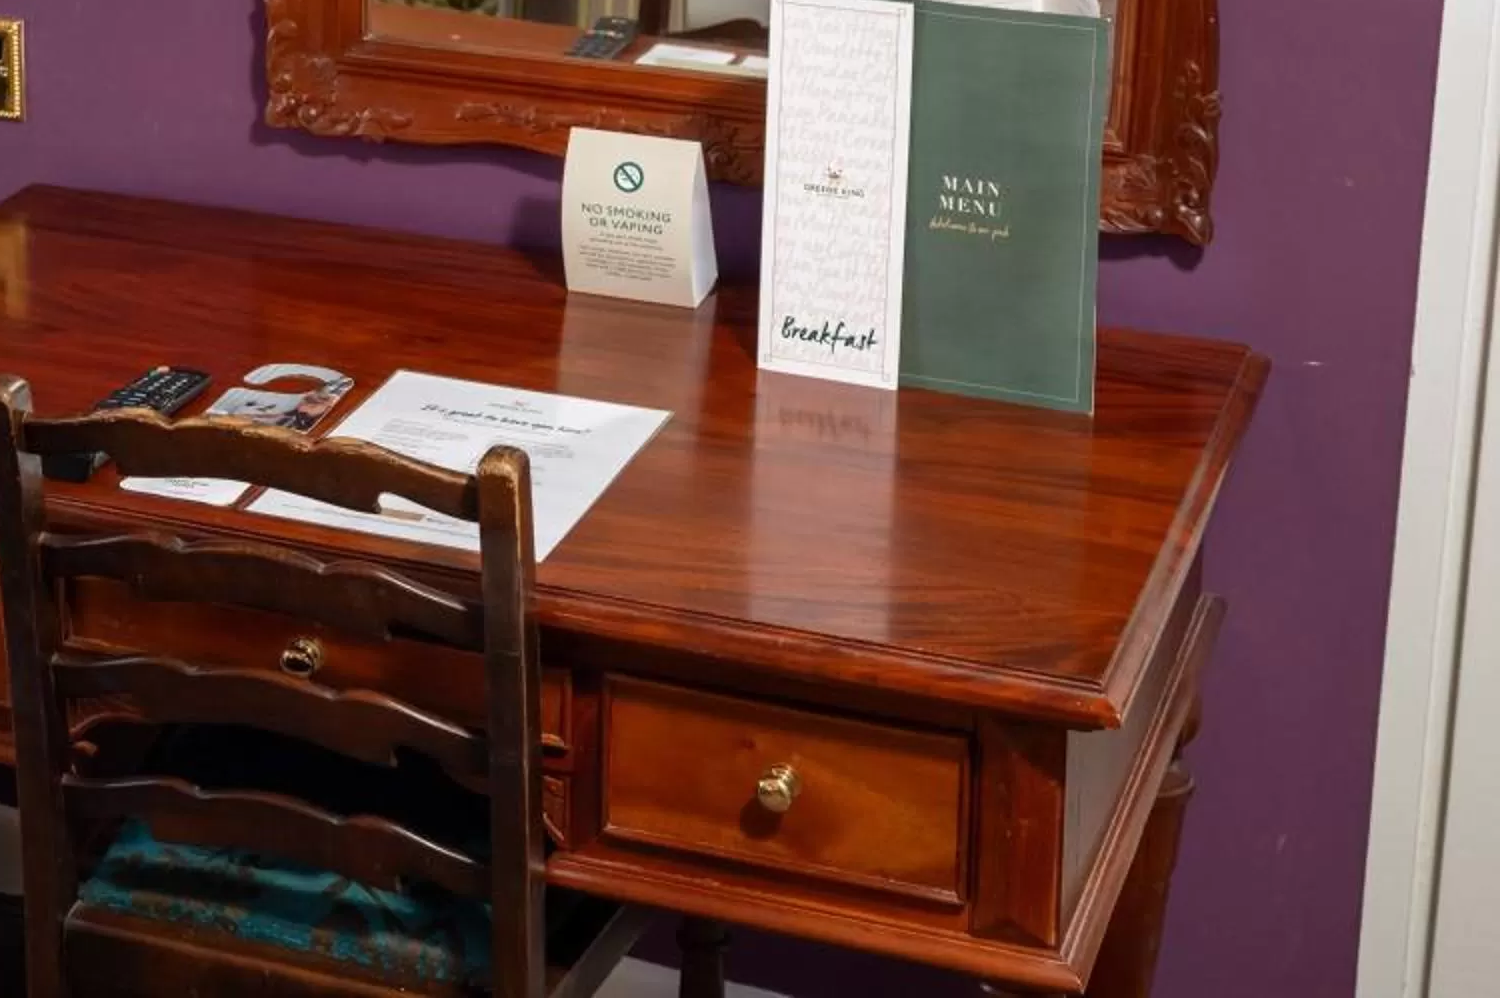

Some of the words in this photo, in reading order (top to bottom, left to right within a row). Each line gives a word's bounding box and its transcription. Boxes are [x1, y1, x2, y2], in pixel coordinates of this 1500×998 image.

[942, 175, 1000, 198] MAIN
[581, 202, 603, 215] NO
[605, 205, 672, 223] SMOKING
[940, 194, 1001, 219] MENU
[589, 217, 607, 227] OR
[611, 219, 663, 235] VAPING
[781, 315, 878, 354] Breakfast
